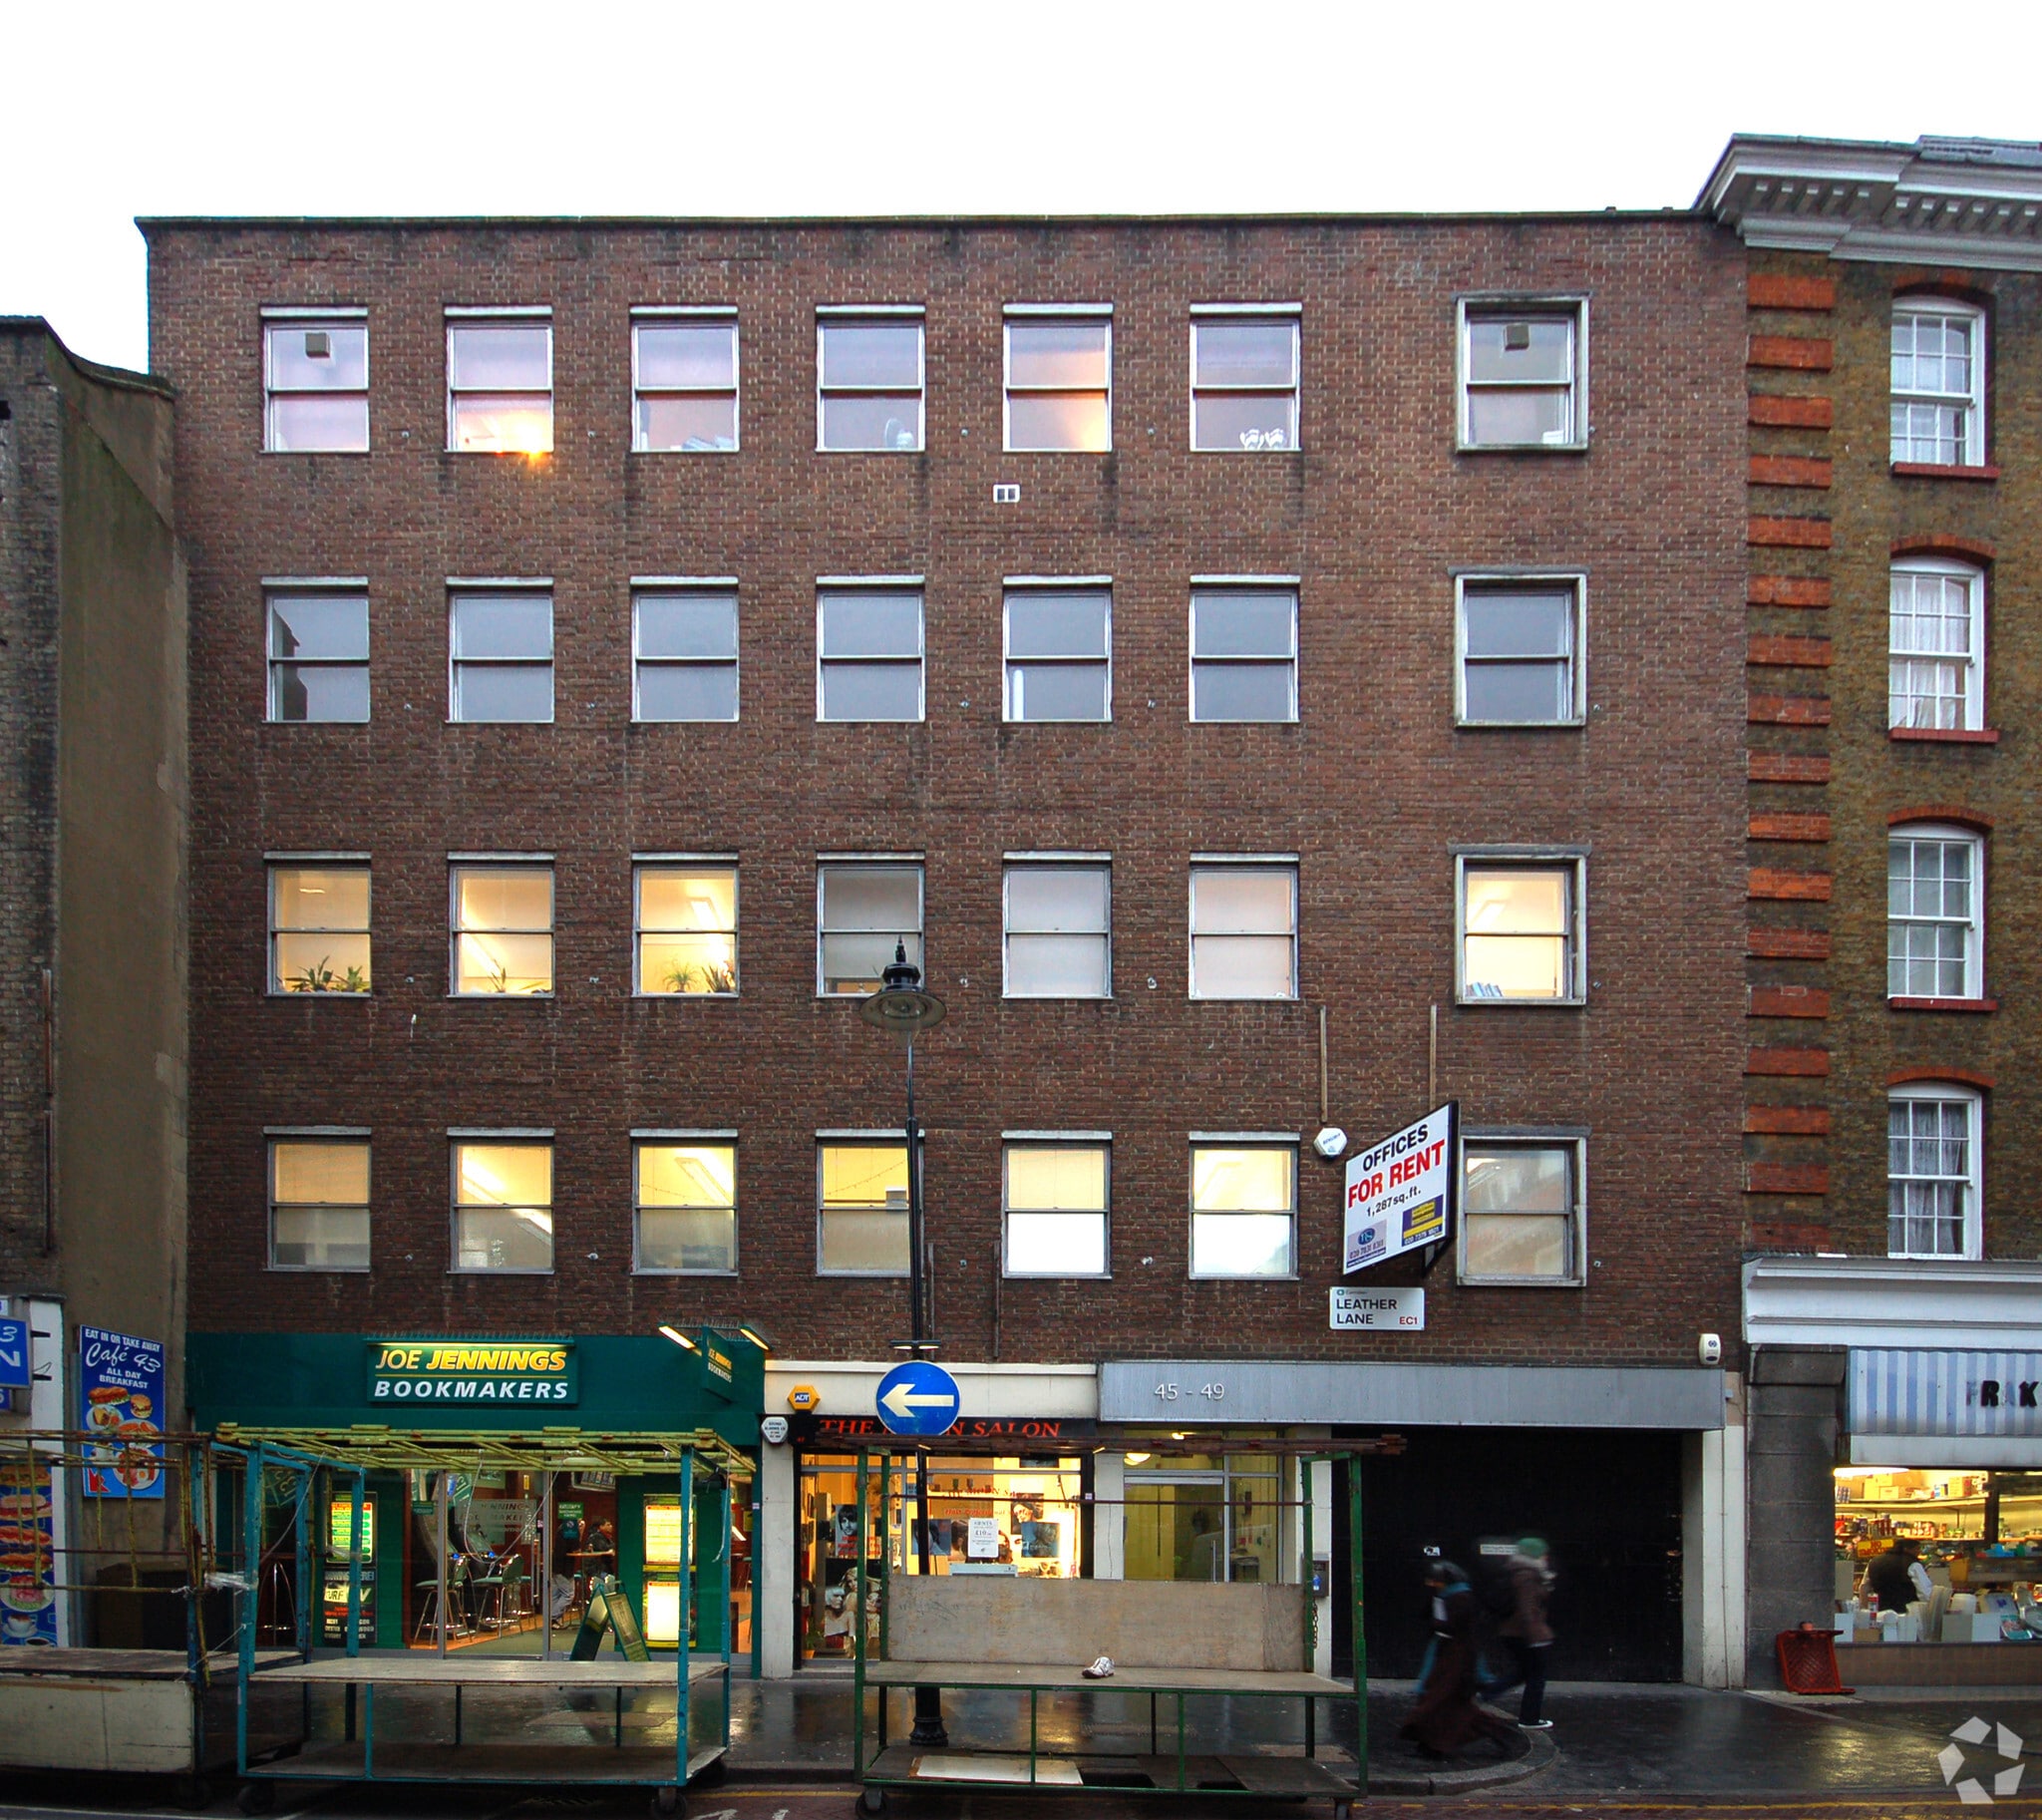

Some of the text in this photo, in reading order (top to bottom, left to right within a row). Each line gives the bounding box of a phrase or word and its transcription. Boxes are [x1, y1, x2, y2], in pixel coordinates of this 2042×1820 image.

[1363, 1124, 1429, 1172] OFFICES
[1348, 1139, 1445, 1209] FOR RENT
[1336, 1298, 1397, 1309] LEATHER
[1336, 1313, 1374, 1324] LANE
[0, 1325, 18, 1342] 3
[85, 1328, 161, 1352] EAT IN OR TAKE AWAY
[85, 1341, 162, 1373] Café 43
[375, 1349, 567, 1371] JOE JENNINGS
[99, 1374, 149, 1388] BREAKFAST
[106, 1366, 143, 1379] ALL DAY
[374, 1380, 568, 1399] BOOKMAKERS
[795, 1393, 810, 1402] ADT
[1155, 1383, 1179, 1400] 45
[1199, 1383, 1225, 1400] 49
[820, 1420, 873, 1435] THE
[972, 1421, 1062, 1438] SALON
